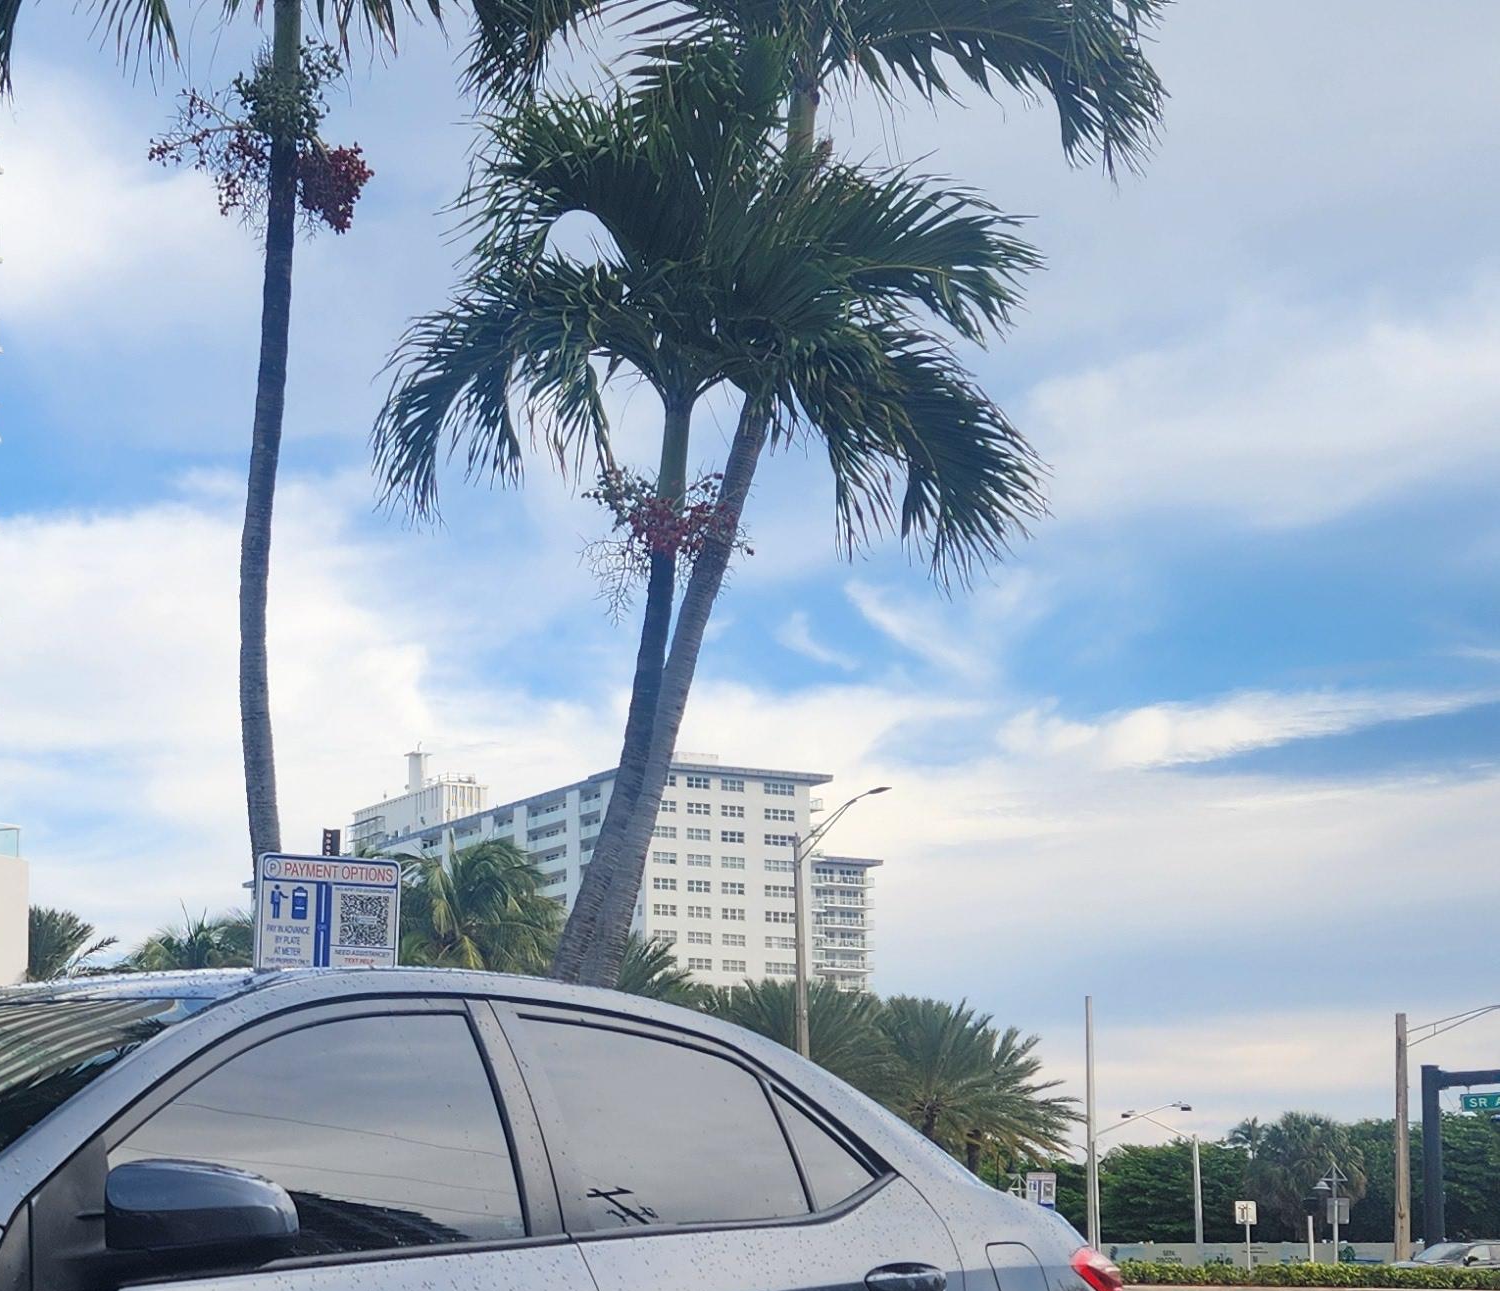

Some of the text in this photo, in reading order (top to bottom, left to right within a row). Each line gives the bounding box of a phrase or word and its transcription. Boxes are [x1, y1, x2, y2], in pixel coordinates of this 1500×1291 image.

[284, 862, 339, 878] PAYMENT
[342, 865, 393, 882] OPTIONS
[266, 924, 277, 932] PAY
[284, 925, 310, 935] ADVANCE
[275, 936, 301, 945] BY PLATE
[274, 946, 301, 956] AT METER
[1469, 1097, 1488, 1108] SR
